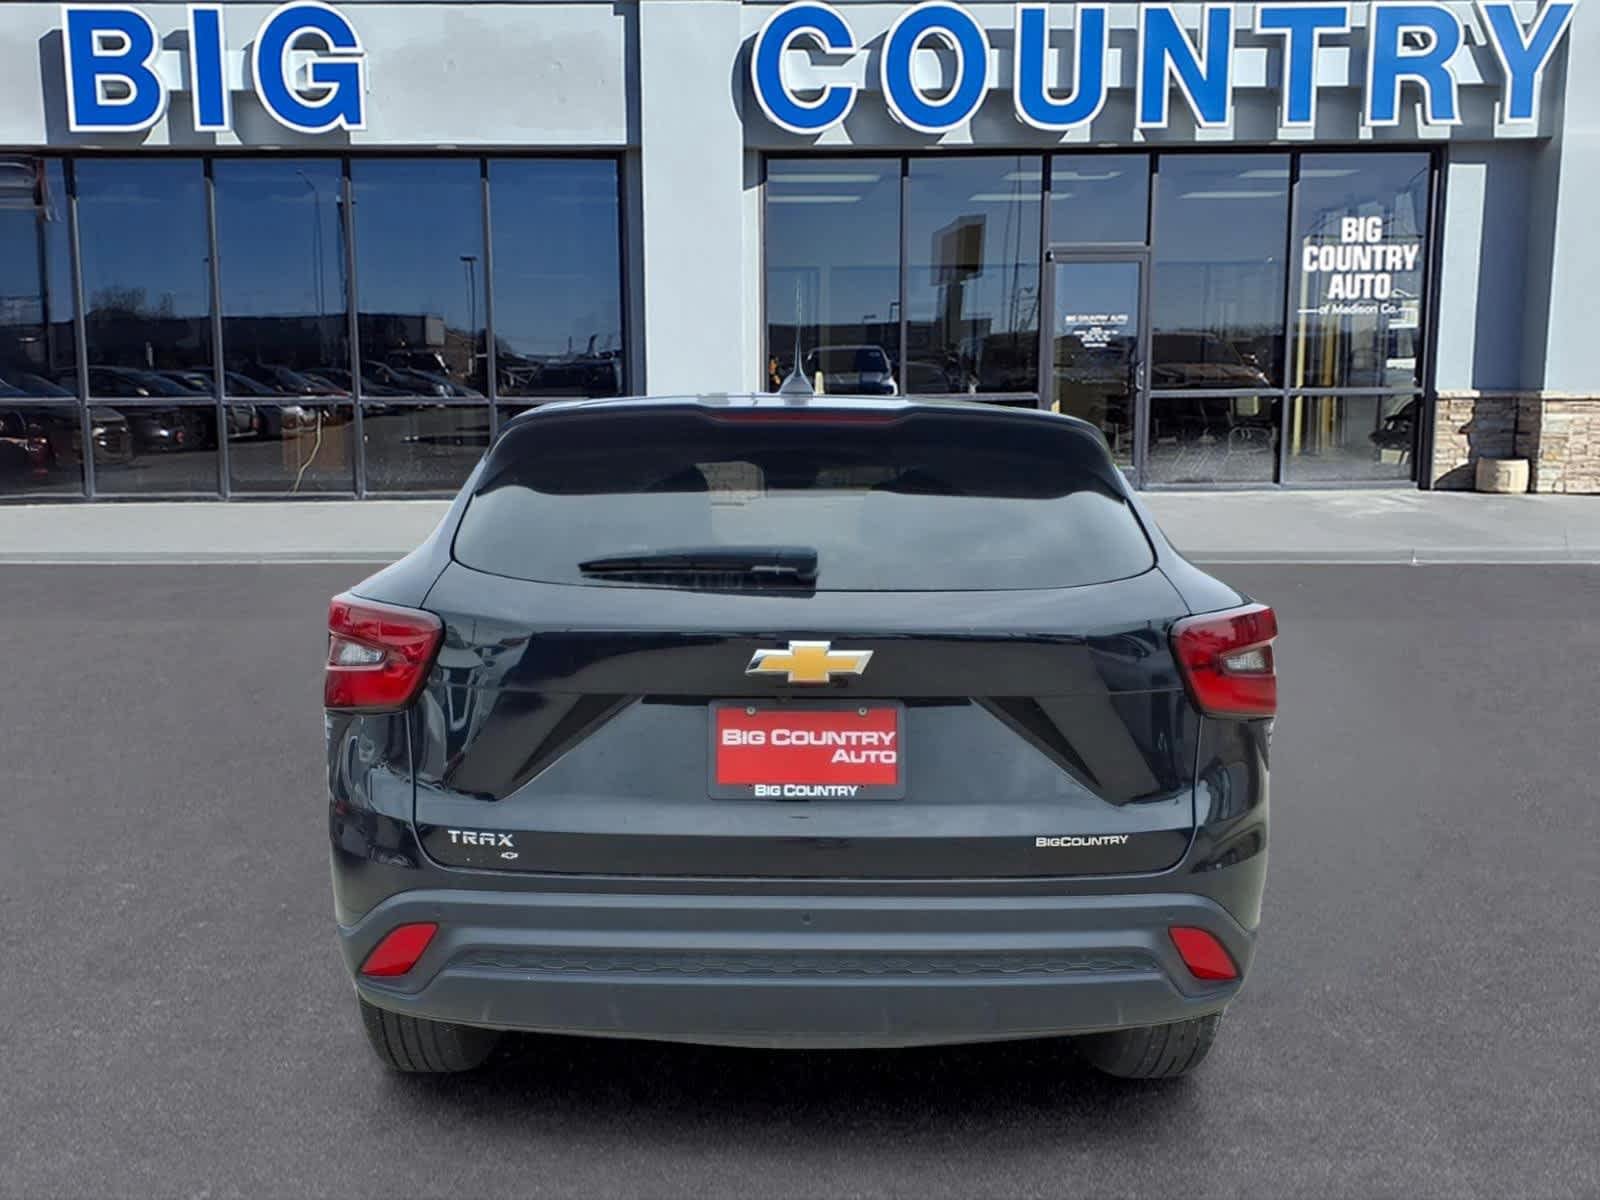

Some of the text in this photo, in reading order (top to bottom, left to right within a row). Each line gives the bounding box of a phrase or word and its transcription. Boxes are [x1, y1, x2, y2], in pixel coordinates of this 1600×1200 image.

[66, 1, 1575, 134] BIG COUNTRY
[1341, 216, 1382, 243] BIG
[1303, 244, 1419, 272] COUNTRY
[1328, 273, 1391, 299] AUTO
[832, 750, 896, 764] AUTO
[448, 830, 514, 847] TRAX
